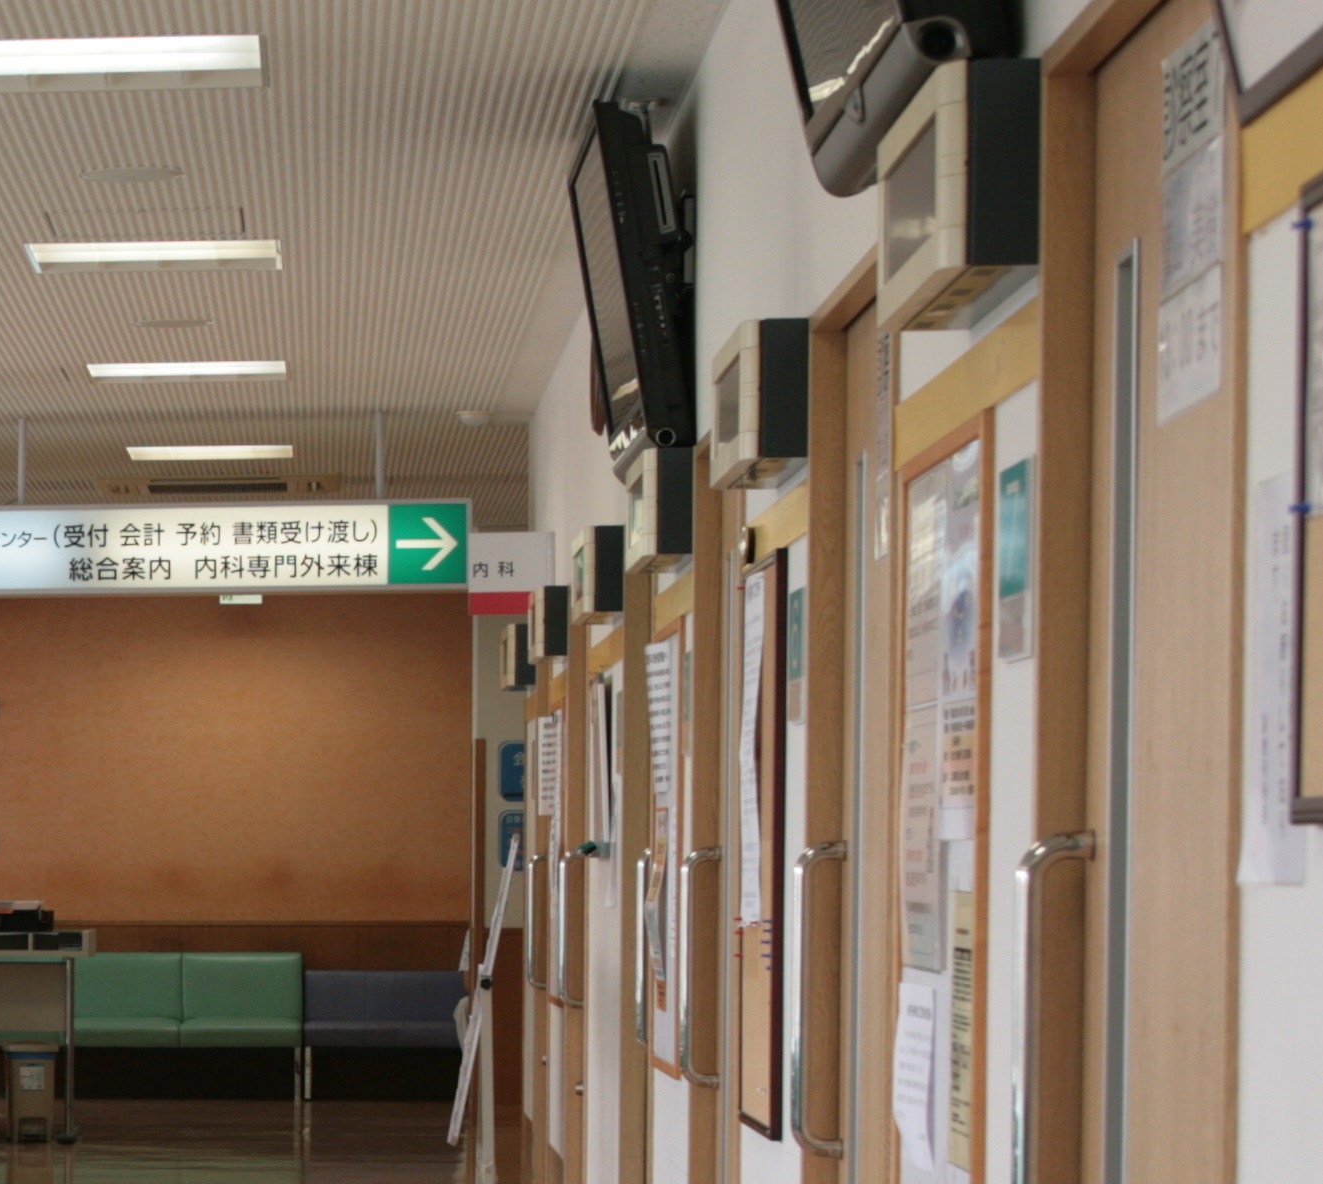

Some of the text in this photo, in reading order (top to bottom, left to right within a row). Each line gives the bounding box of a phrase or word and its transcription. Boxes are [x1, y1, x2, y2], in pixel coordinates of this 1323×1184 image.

[120, 522, 165, 547] 会計
[176, 522, 221, 547] 予約
[68, 553, 378, 582] 総合案内 内科専門外来棟
[472, 561, 515, 578] 内科
